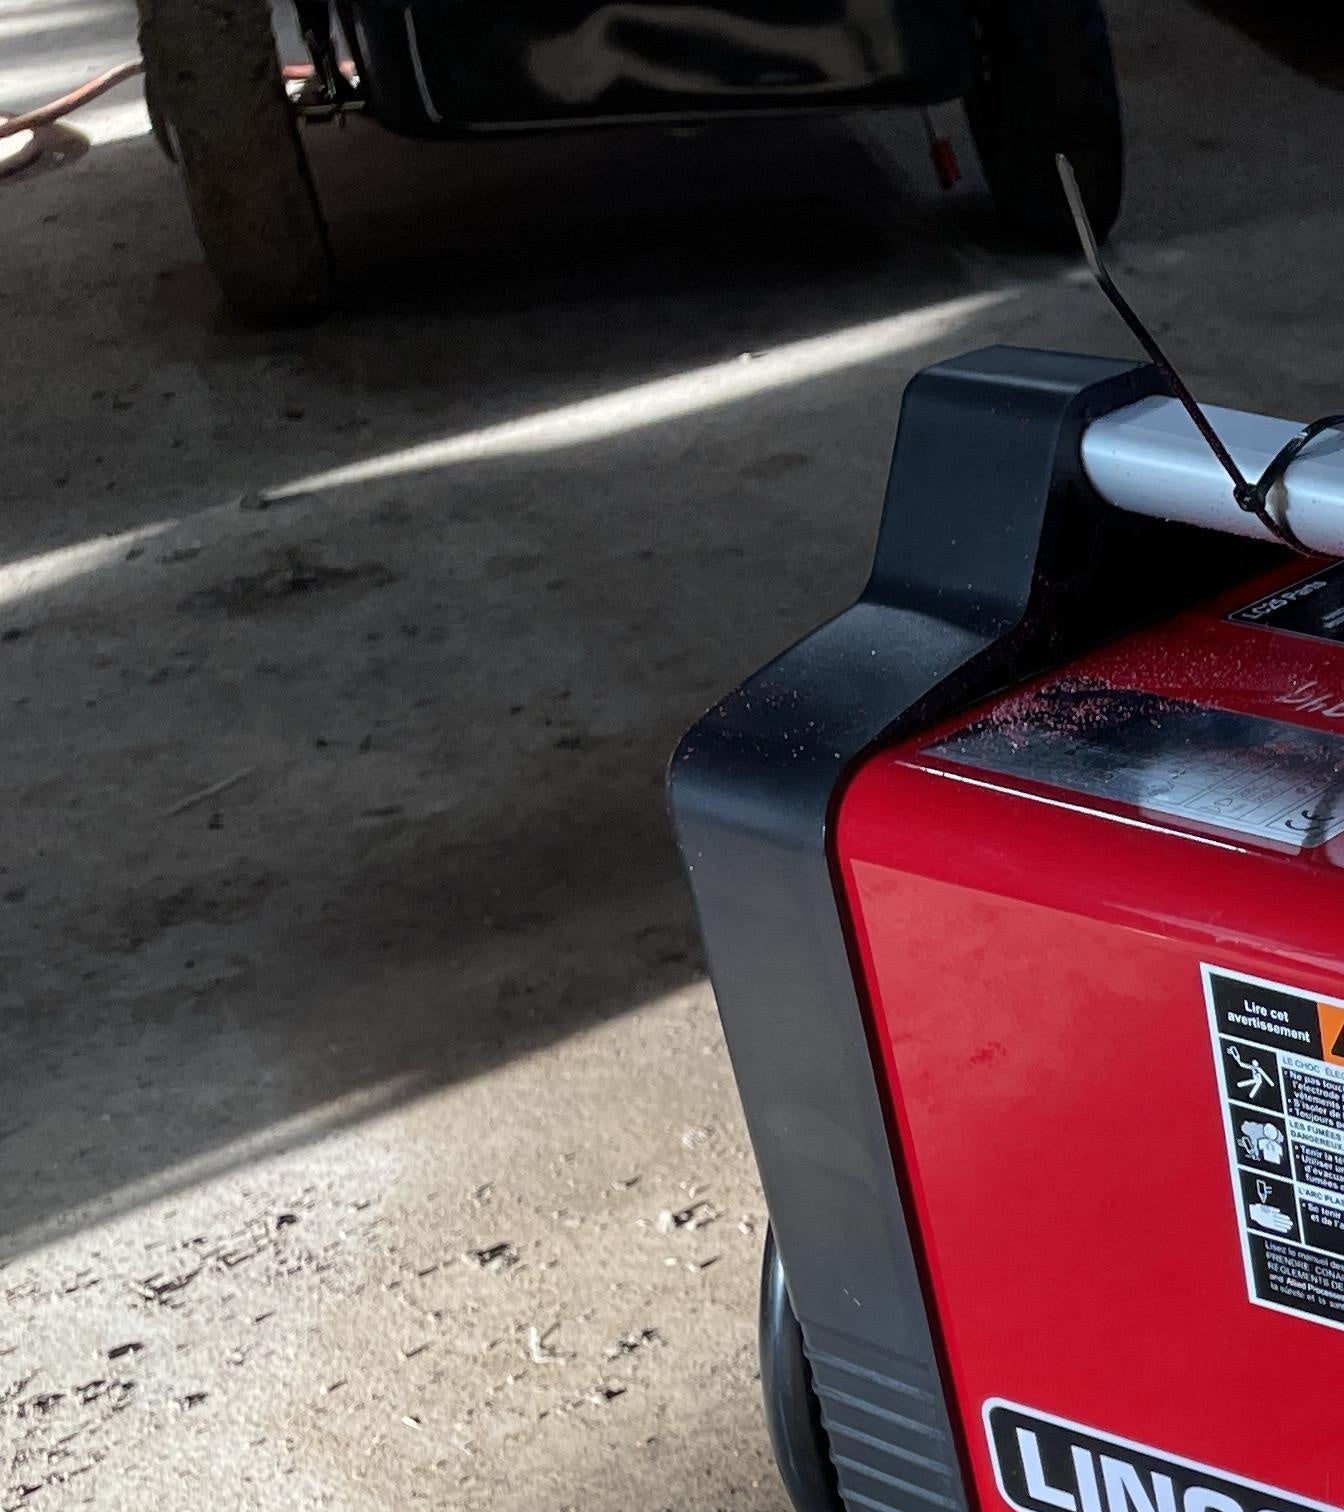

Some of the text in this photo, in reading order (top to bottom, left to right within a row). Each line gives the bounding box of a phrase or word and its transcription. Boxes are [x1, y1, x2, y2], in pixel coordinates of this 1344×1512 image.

[1244, 999, 1289, 1022] Lire cet
[1226, 1008, 1310, 1042] avertissement
